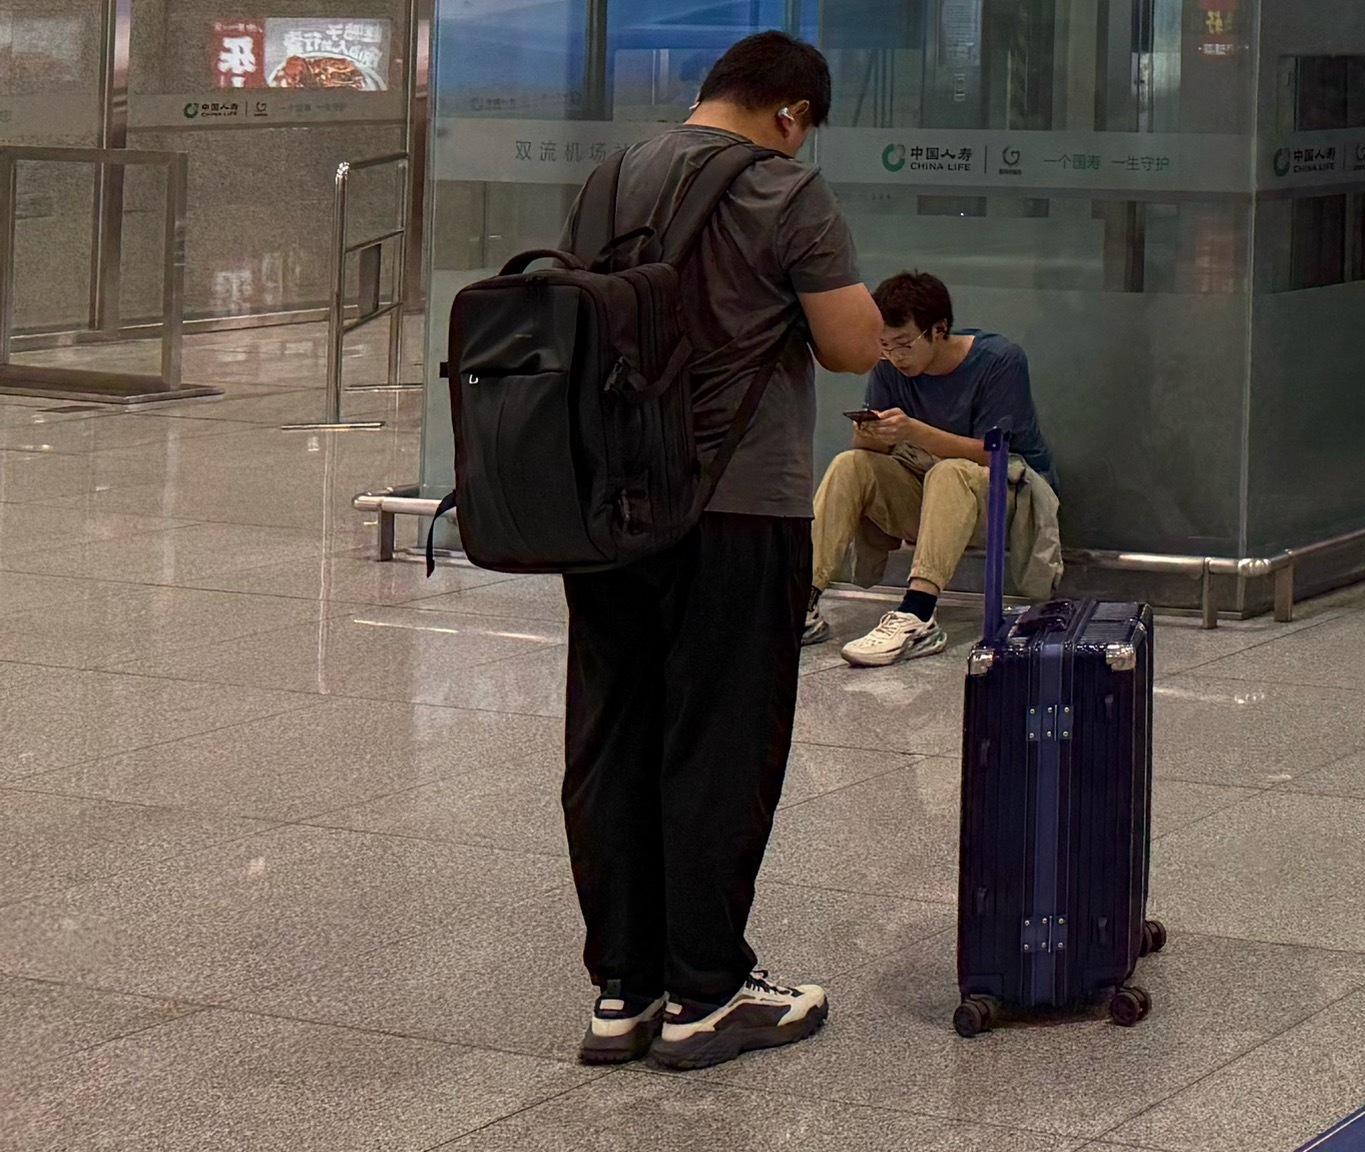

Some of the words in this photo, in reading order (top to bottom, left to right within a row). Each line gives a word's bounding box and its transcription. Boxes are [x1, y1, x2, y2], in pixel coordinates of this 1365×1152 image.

[515, 139, 630, 162] 双流机场
[910, 146, 973, 162] 中国人寿
[910, 162, 944, 172] CHINA
[947, 162, 972, 172] LIFE
